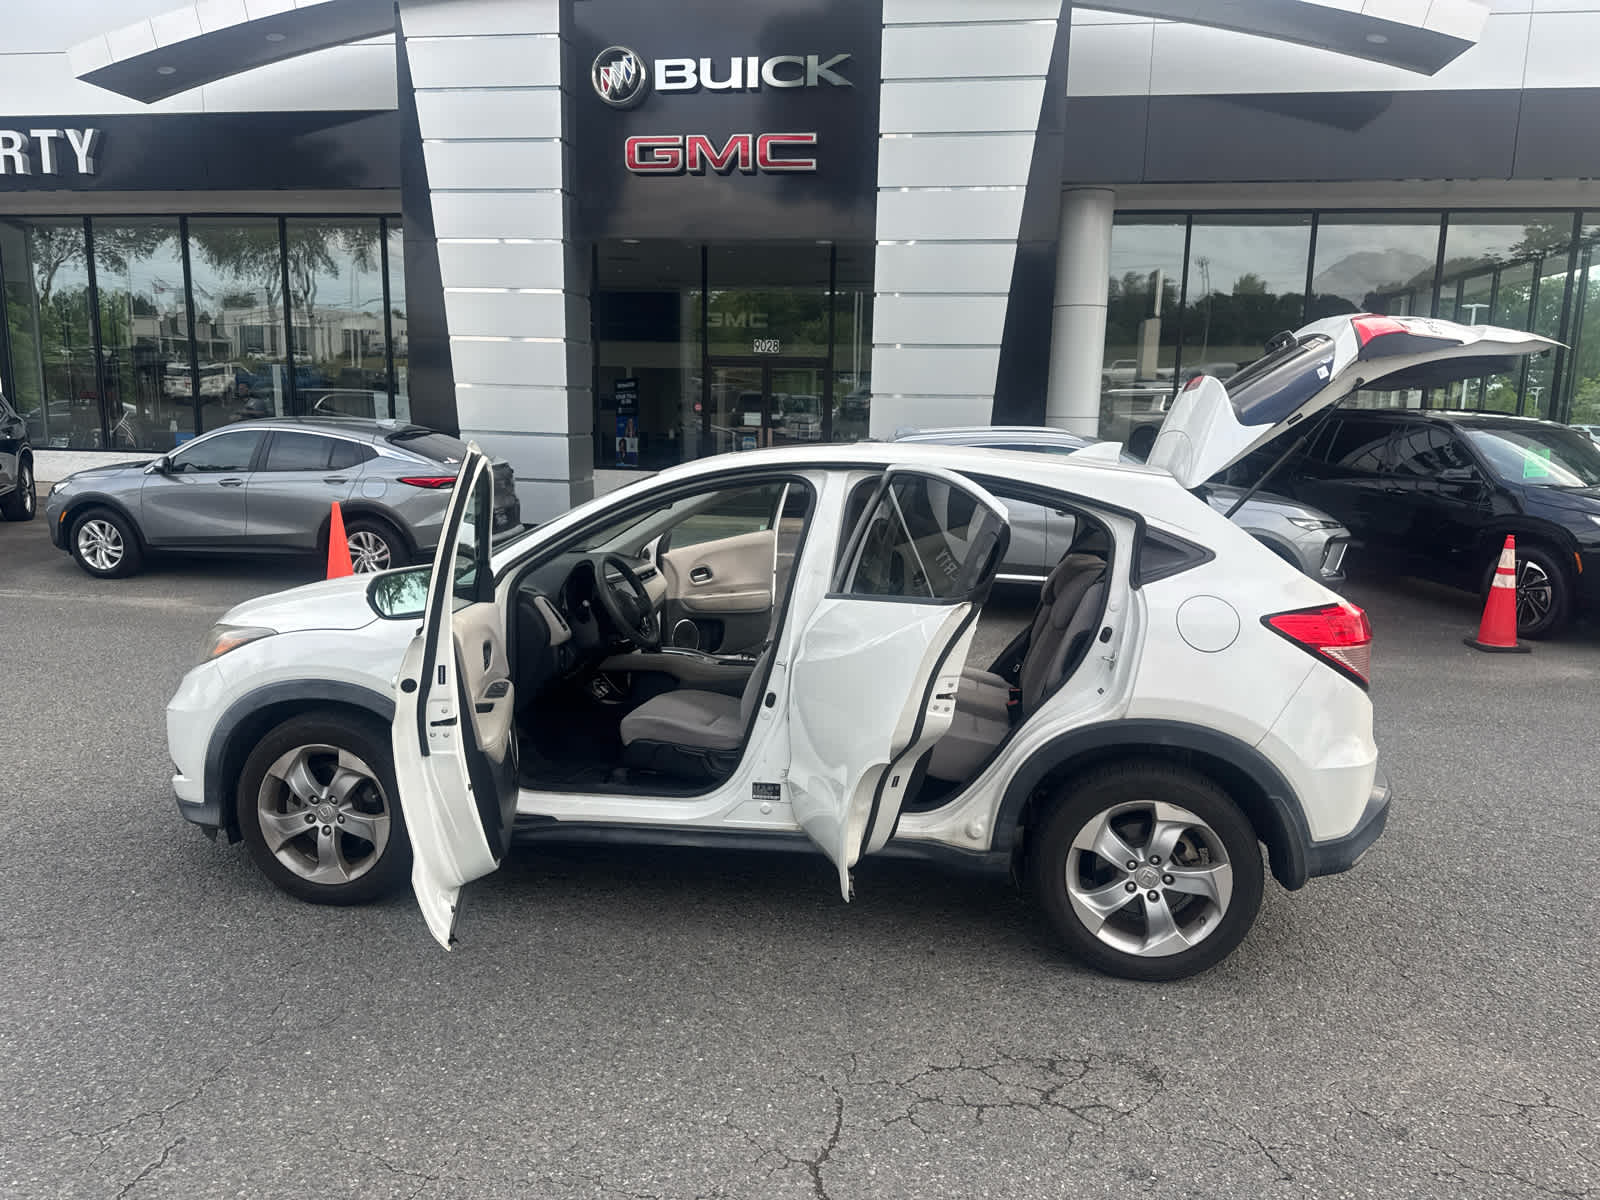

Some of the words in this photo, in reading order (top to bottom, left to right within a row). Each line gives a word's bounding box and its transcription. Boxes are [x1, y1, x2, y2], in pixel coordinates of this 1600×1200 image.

[654, 54, 854, 90] BUICK
[0, 128, 97, 174] RTY
[625, 133, 816, 172] GMC
[753, 339, 780, 353] 9028
